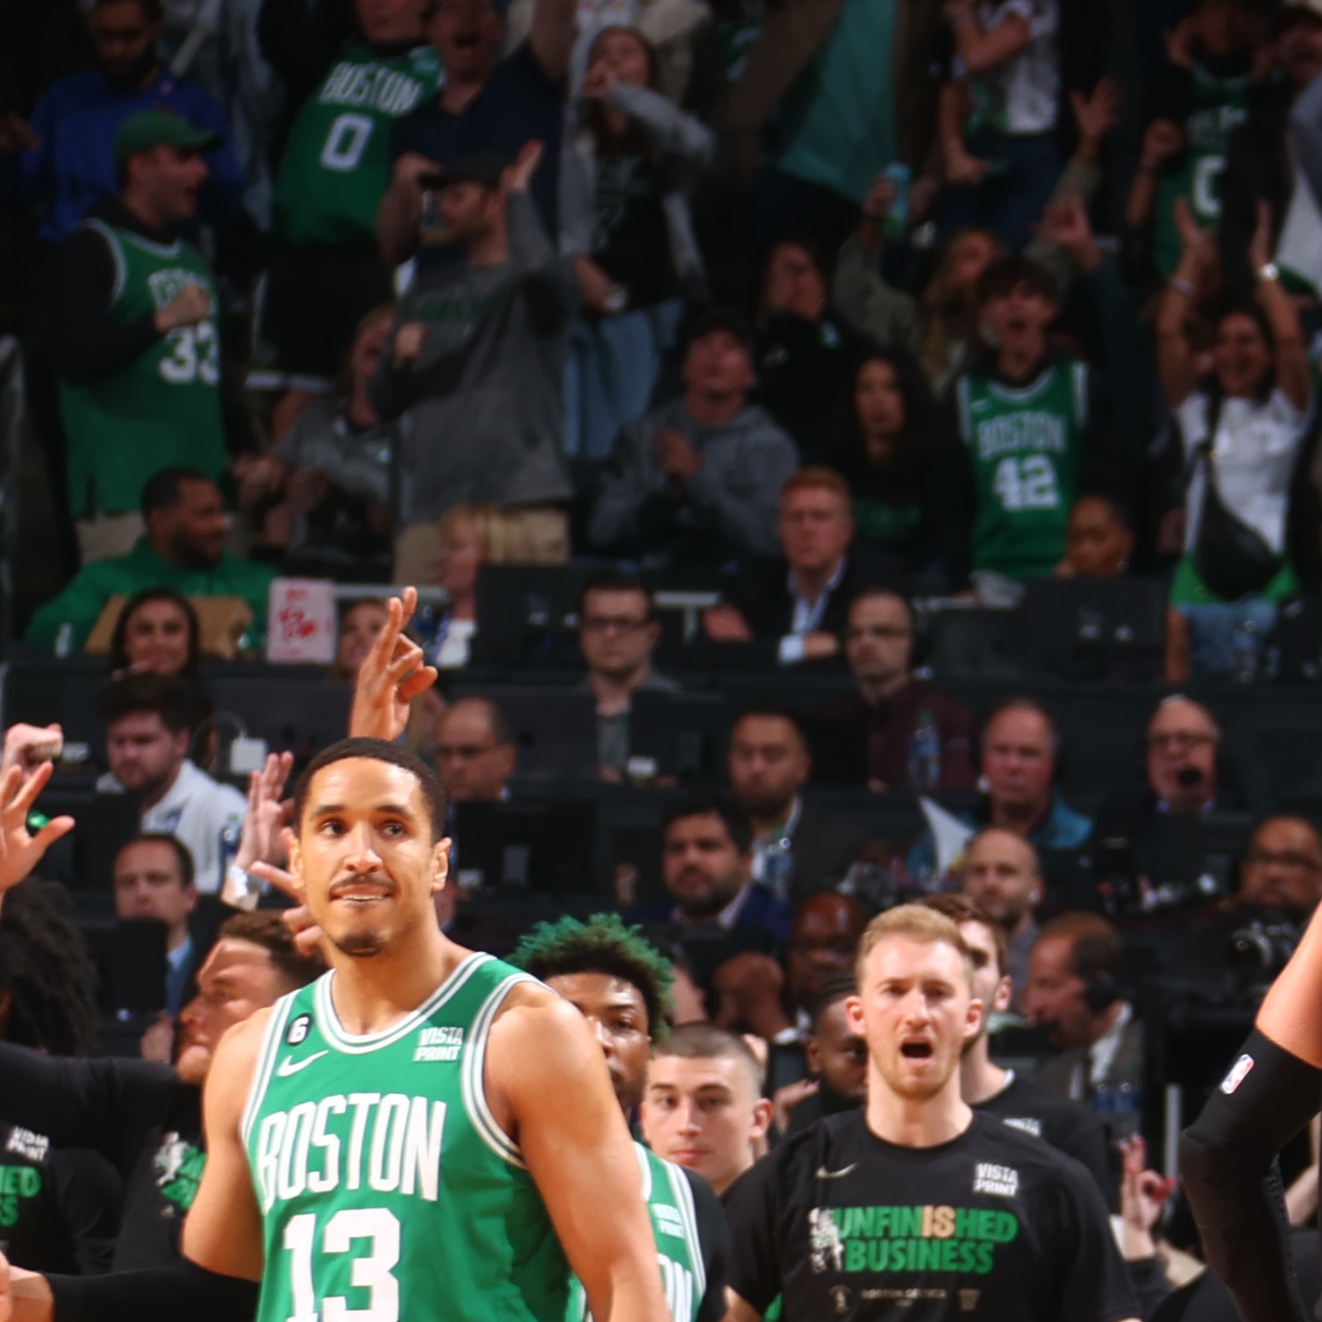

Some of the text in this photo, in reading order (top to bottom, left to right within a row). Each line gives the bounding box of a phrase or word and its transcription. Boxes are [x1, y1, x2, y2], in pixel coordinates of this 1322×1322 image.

[320, 112, 375, 172] 0
[991, 453, 1060, 512] 42
[286, 1014, 312, 1047] 6
[416, 1025, 465, 1047] VISTA
[412, 1044, 463, 1063] PRINT
[255, 1091, 448, 1217] BOSTON
[976, 1160, 1020, 1184] VISTA
[972, 1178, 1020, 1198] PRINT
[832, 1203, 1020, 1243] UNFINISHED
[843, 1237, 997, 1276] BUSINESS
